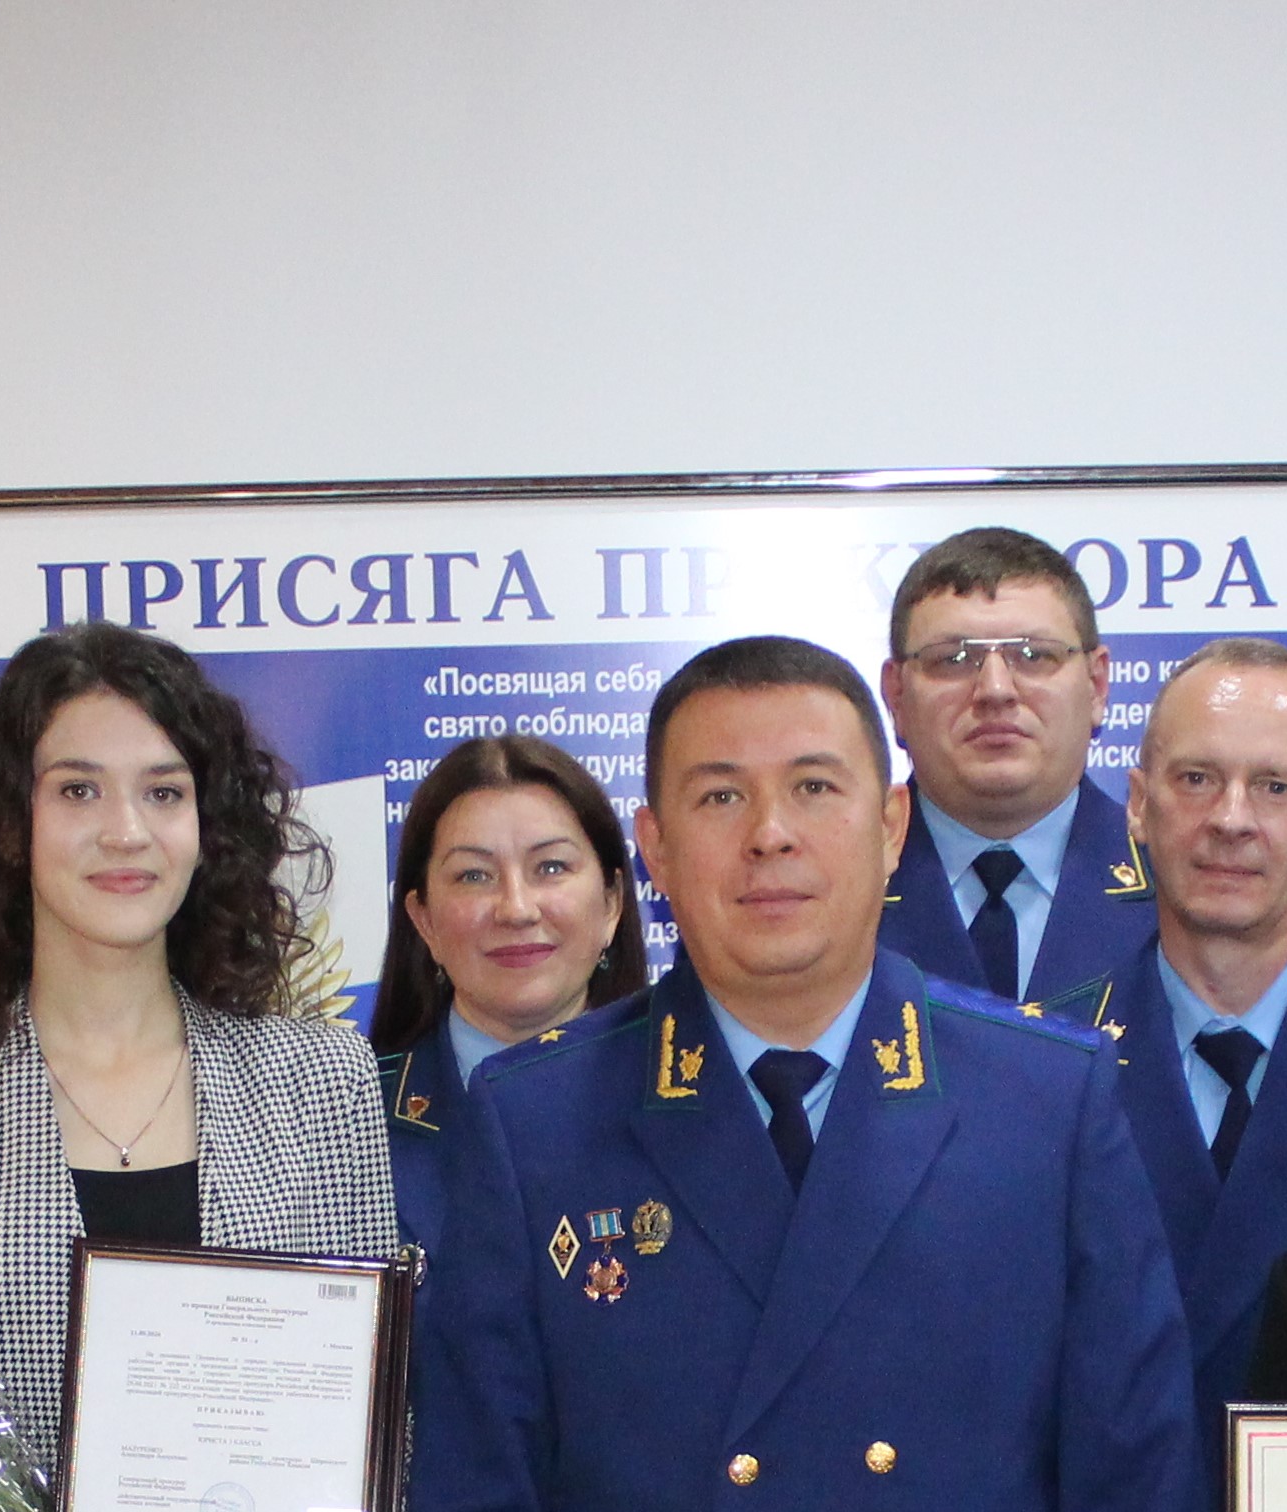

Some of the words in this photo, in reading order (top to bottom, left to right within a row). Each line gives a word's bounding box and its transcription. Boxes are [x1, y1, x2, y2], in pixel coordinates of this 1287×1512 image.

[38, 548, 555, 633] ПРИСЯГА
[423, 664, 586, 699] «Посвящая
[594, 661, 662, 693] себя
[423, 715, 508, 739] свято
[515, 706, 651, 741] соблюда
